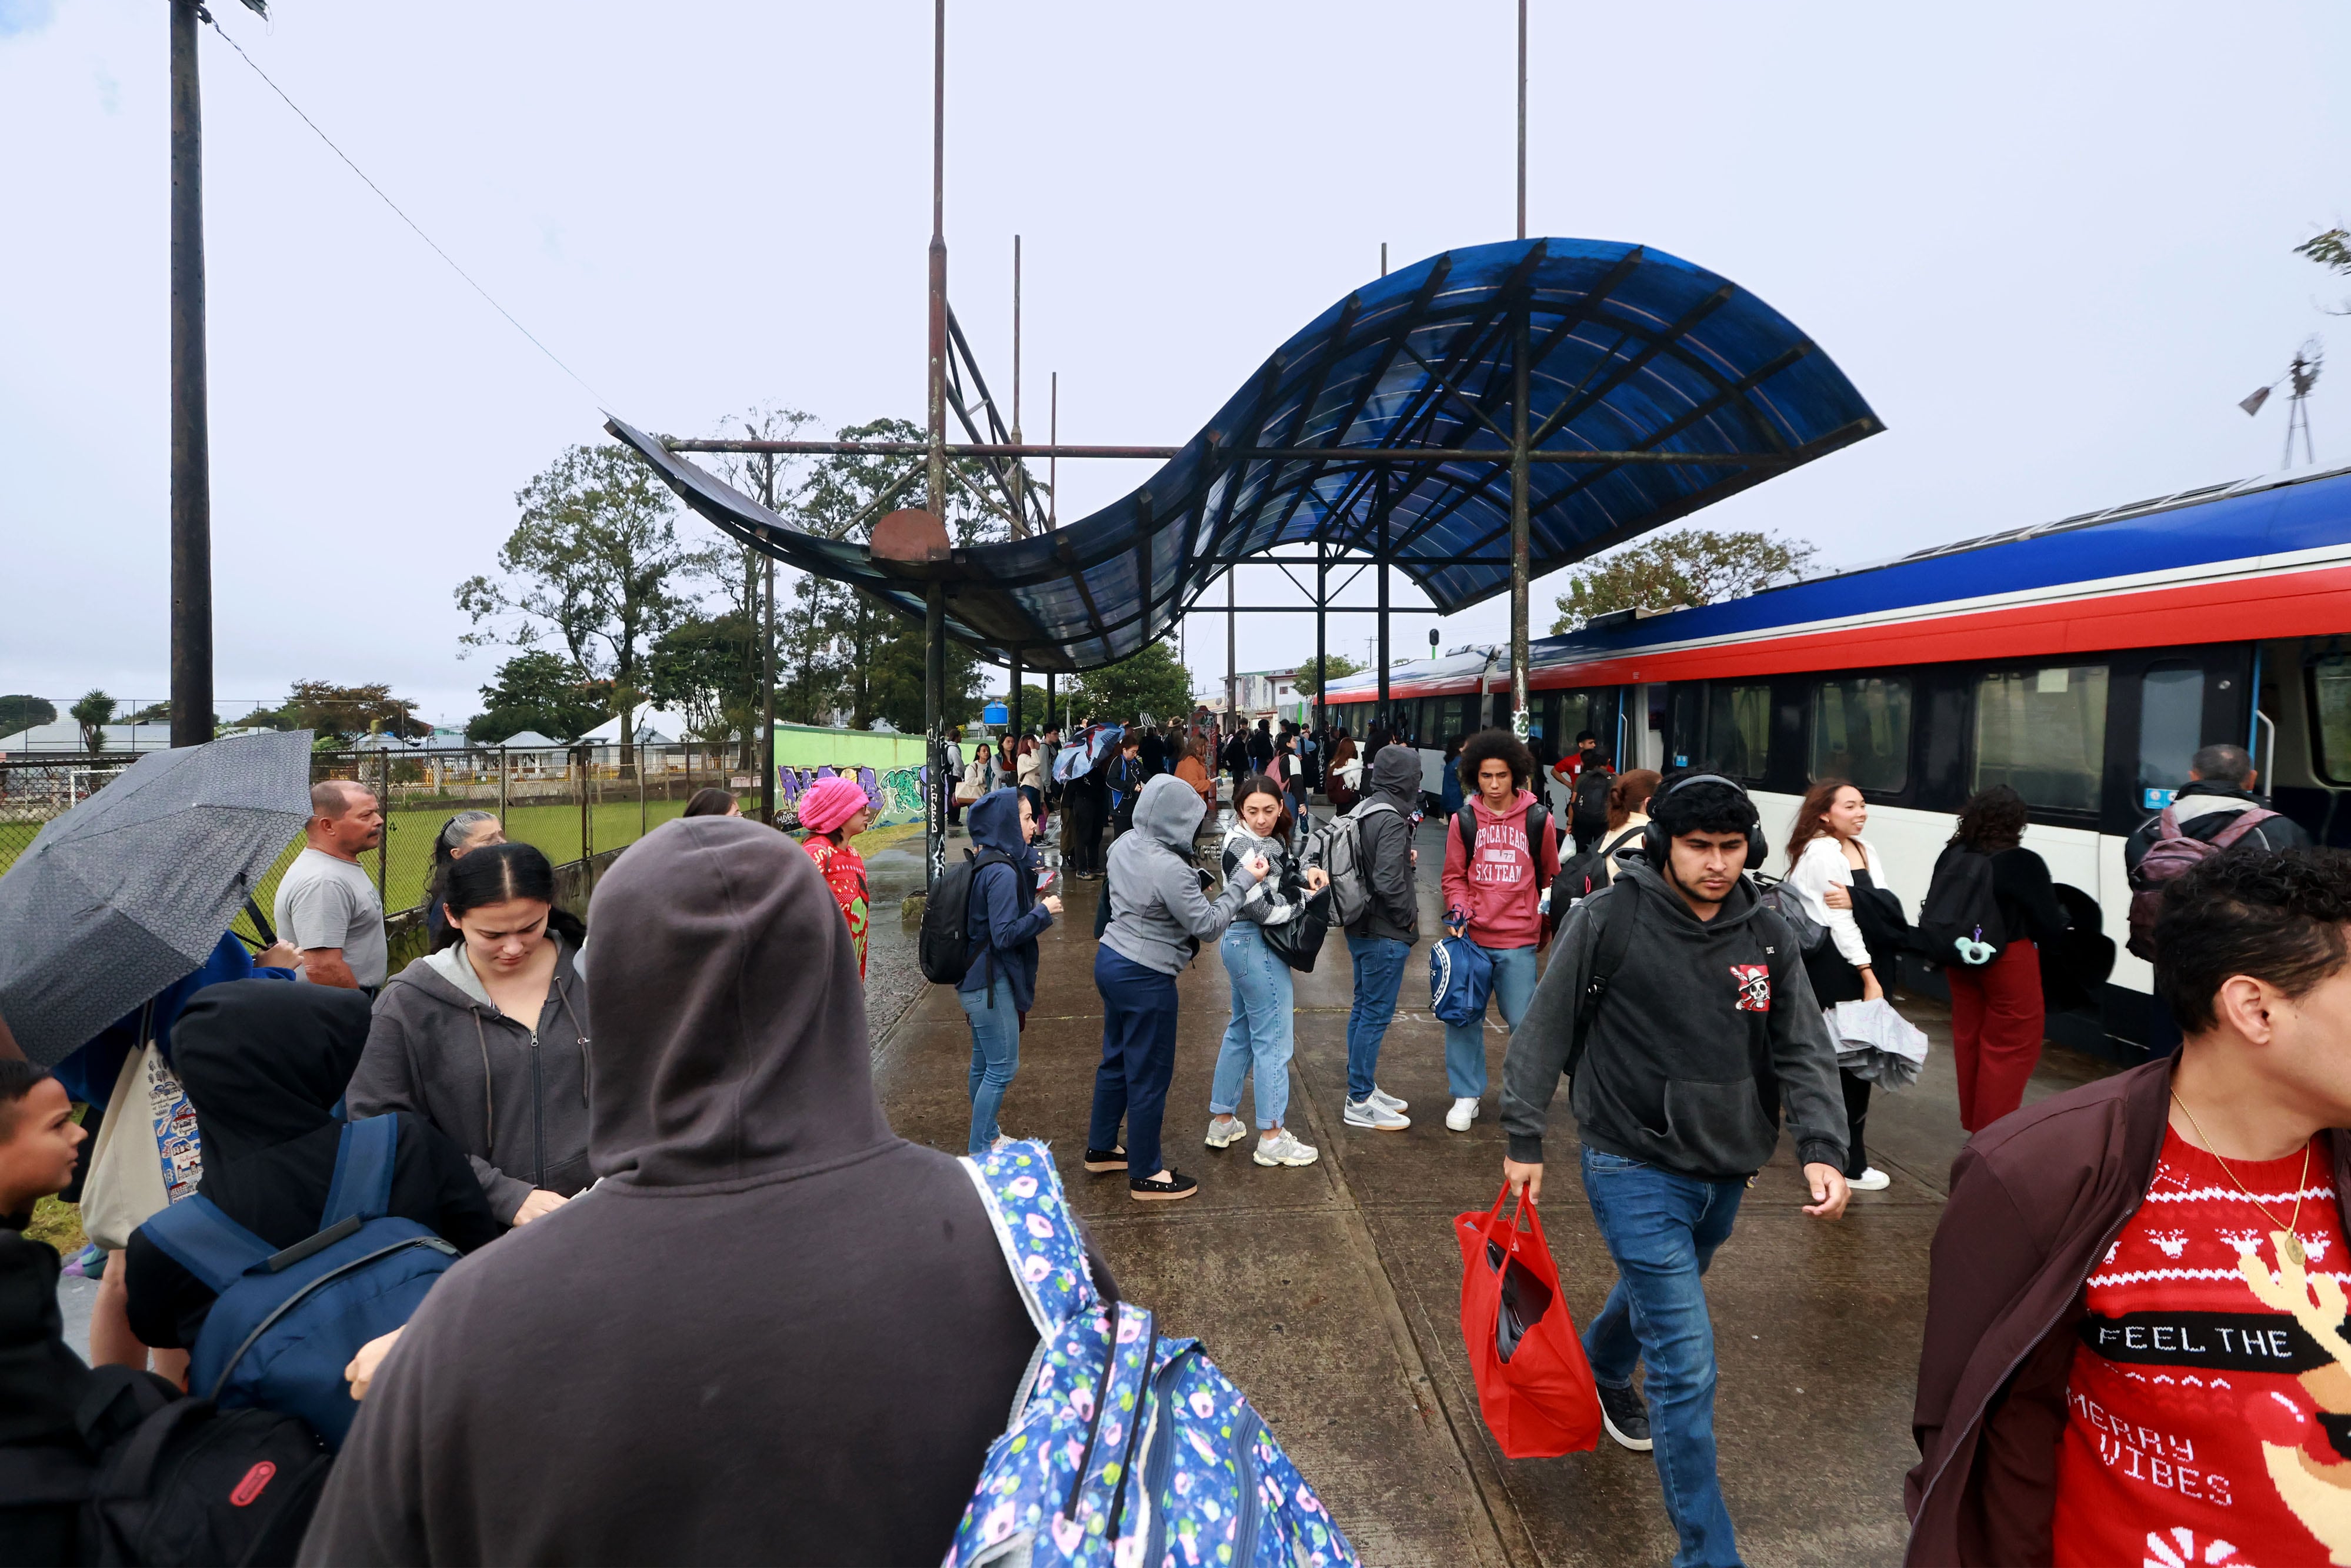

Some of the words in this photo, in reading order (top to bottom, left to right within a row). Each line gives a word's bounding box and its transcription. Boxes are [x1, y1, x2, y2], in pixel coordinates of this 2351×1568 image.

[1473, 825, 1508, 857] MERICAN
[1509, 826, 1530, 859] EAGL
[1476, 863, 1492, 881] SKI
[1495, 864, 1522, 883] TEAM
[2099, 1326, 2206, 1352] FEEL
[2215, 1327, 2293, 1357] THE
[2065, 1385, 2194, 1463] MERRY
[2100, 1433, 2233, 1506] VIBES
